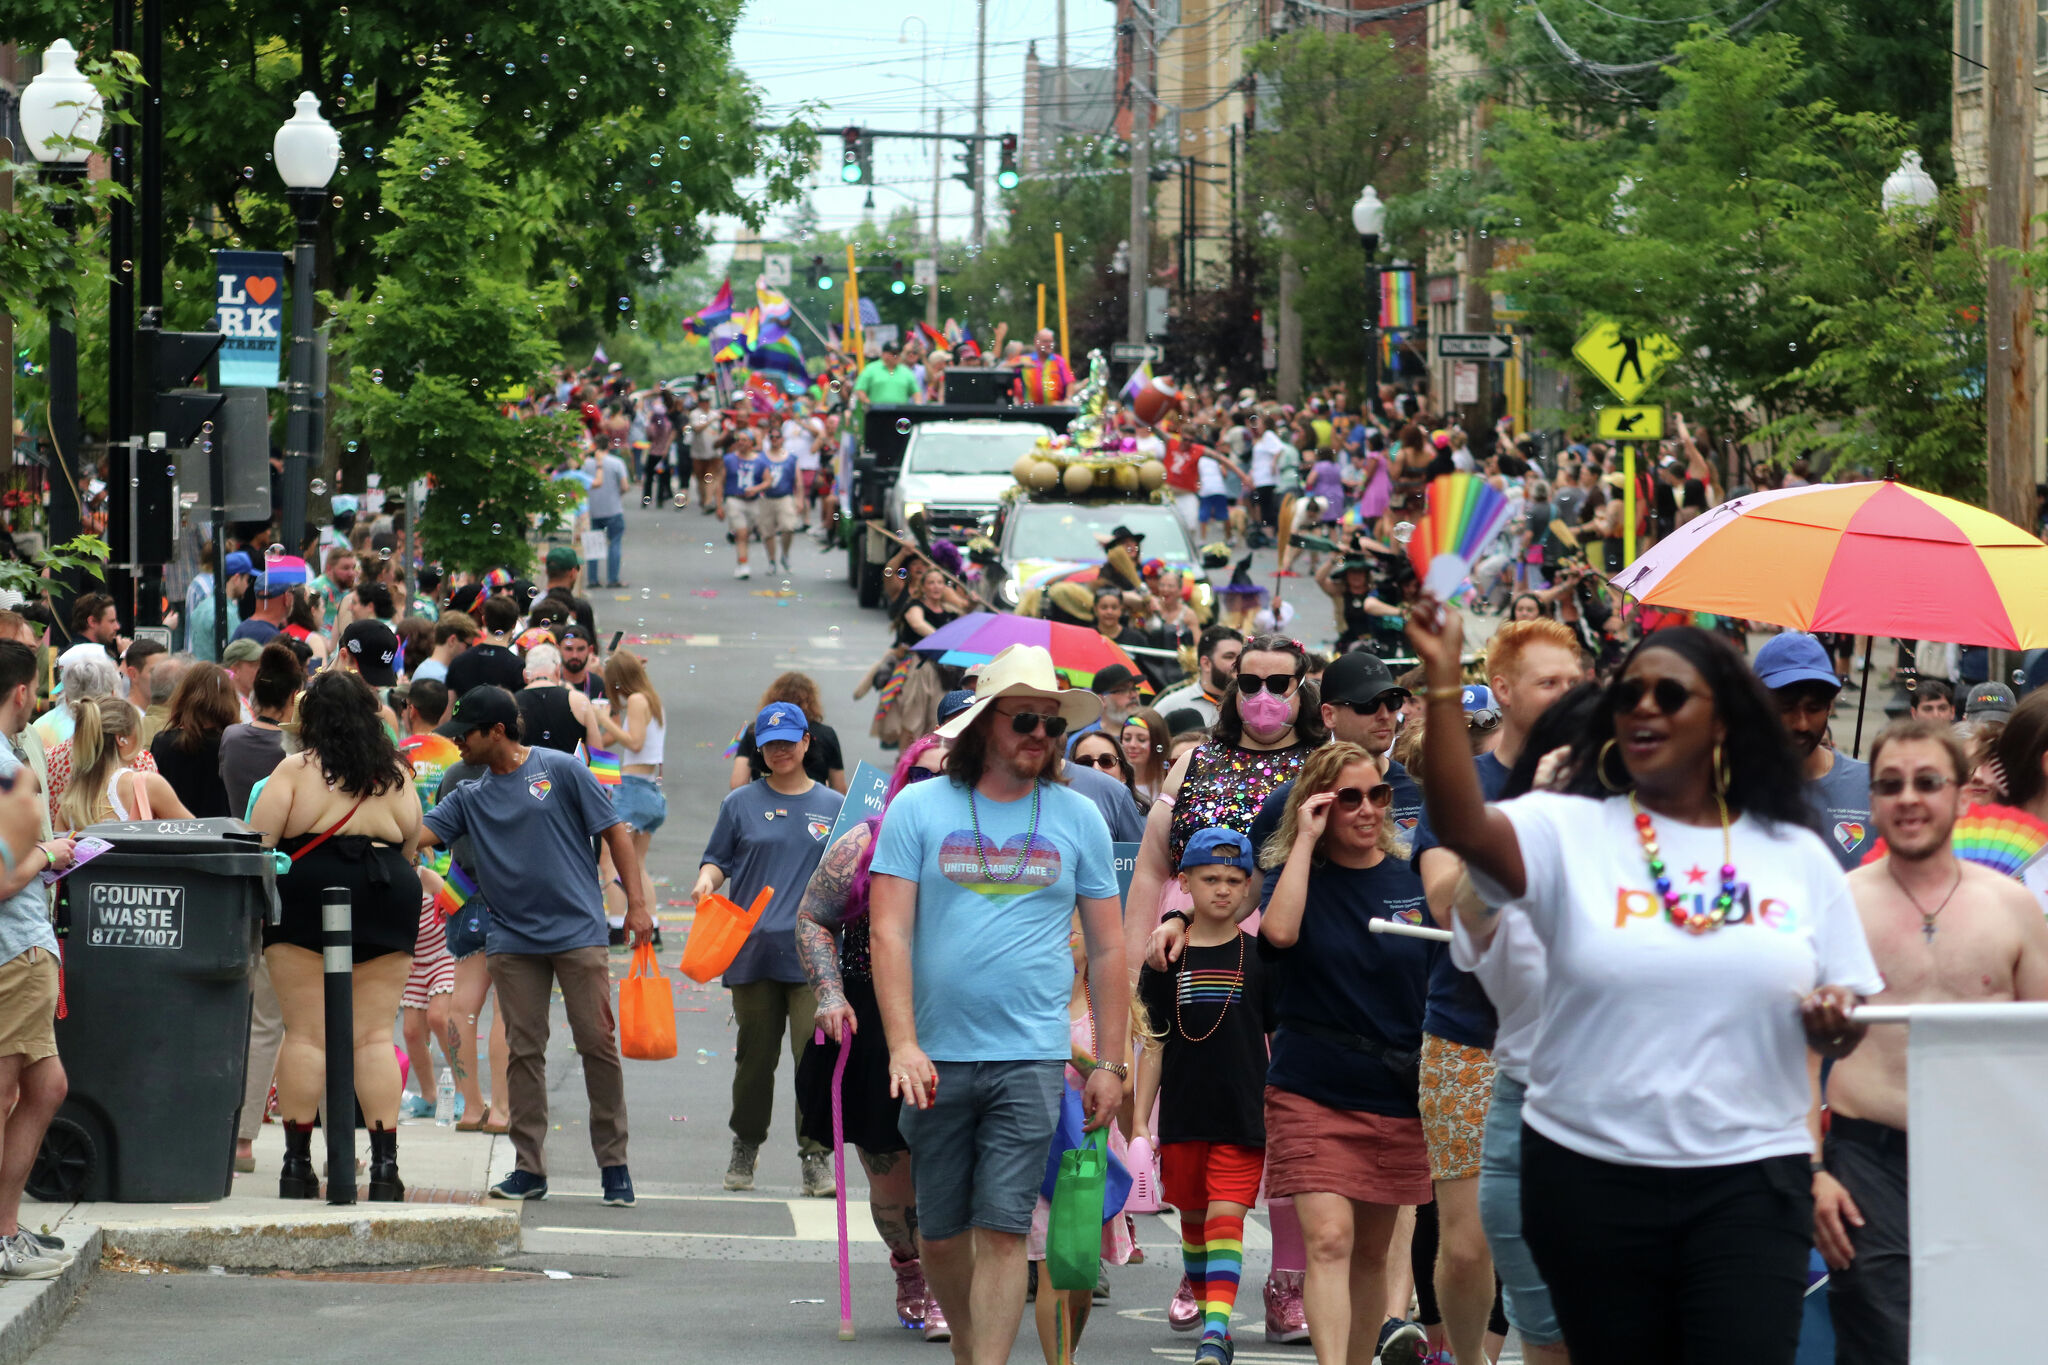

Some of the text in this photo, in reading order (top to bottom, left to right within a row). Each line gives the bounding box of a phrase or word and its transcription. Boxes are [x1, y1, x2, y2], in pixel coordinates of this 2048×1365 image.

[944, 862, 978, 873] UNITED
[1023, 865, 1047, 876] HATE
[93, 886, 180, 906] COUNTY
[98, 907, 172, 928] WASTE
[92, 928, 178, 946] 877-7007
